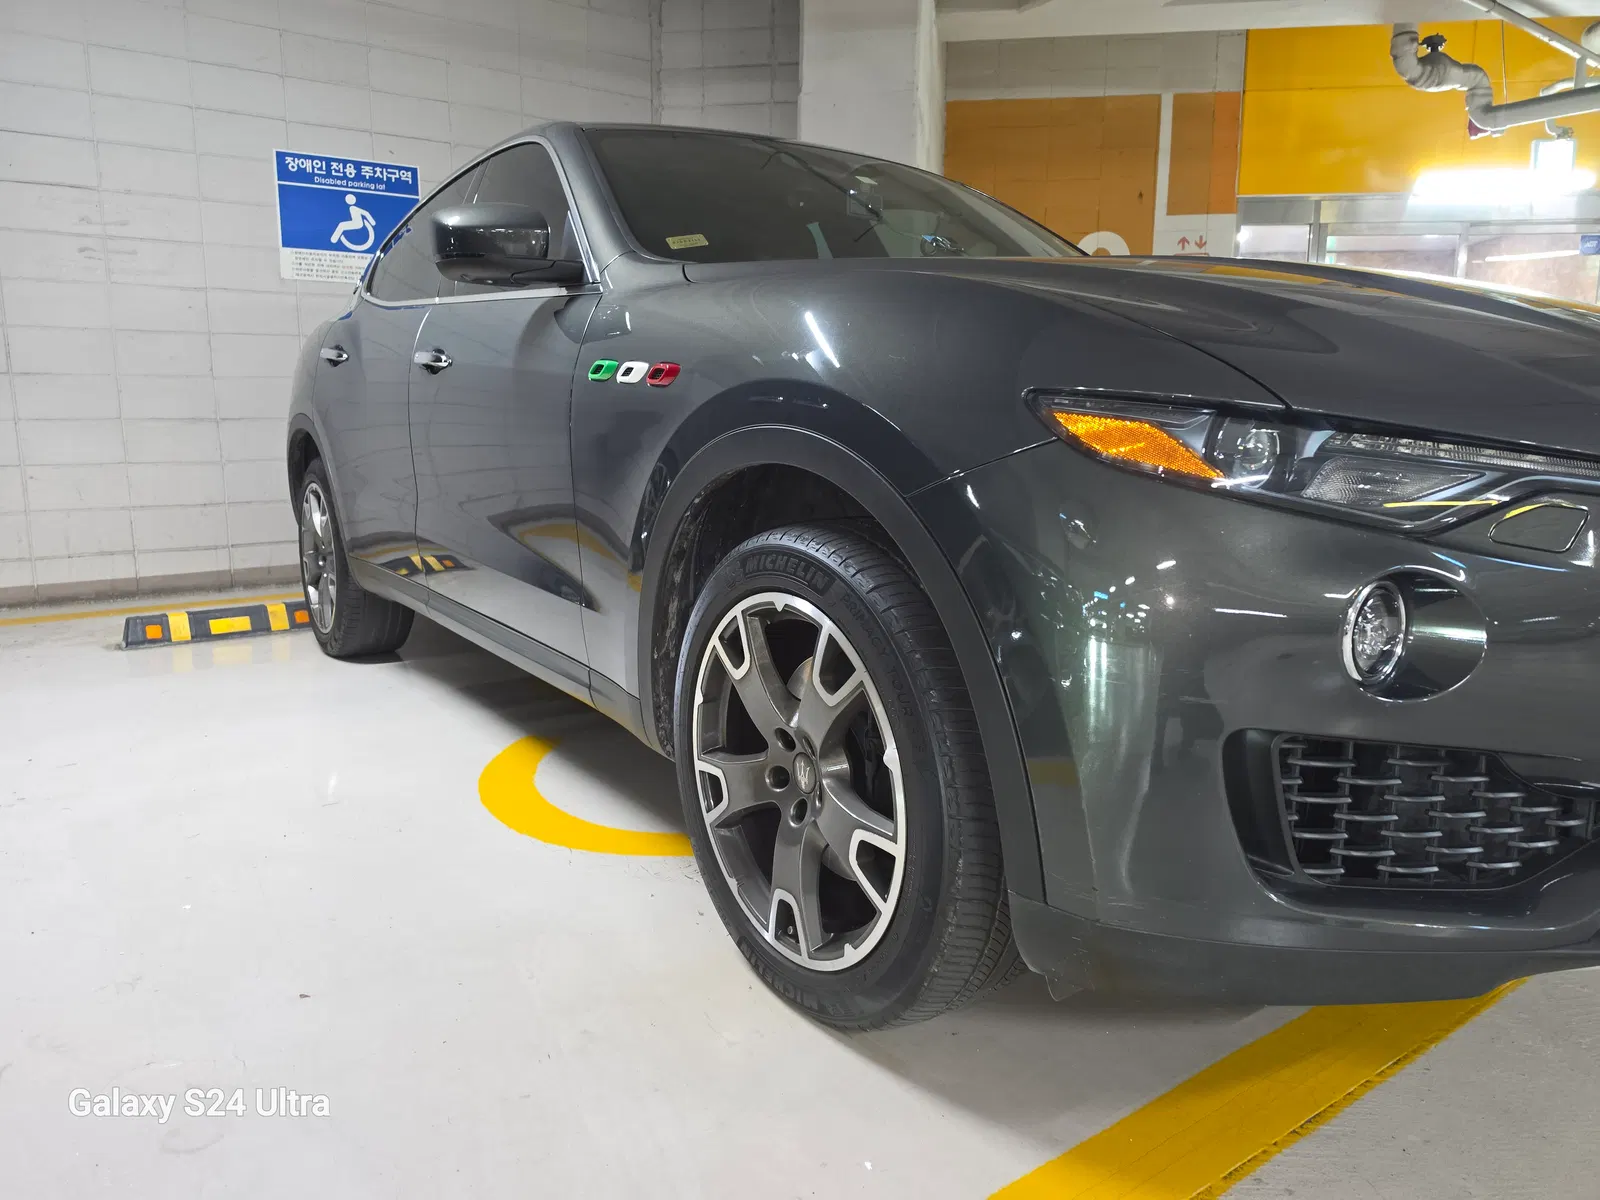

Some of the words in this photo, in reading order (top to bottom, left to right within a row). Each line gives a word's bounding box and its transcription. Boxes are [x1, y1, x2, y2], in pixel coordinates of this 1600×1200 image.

[285, 156, 326, 175] 장애인
[330, 162, 356, 179] 전용
[361, 165, 412, 184] 주차구역
[314, 176, 346, 187] Disabled
[348, 181, 375, 190] parking
[745, 553, 830, 590] MICHELIN
[840, 592, 891, 657] PRIMACY
